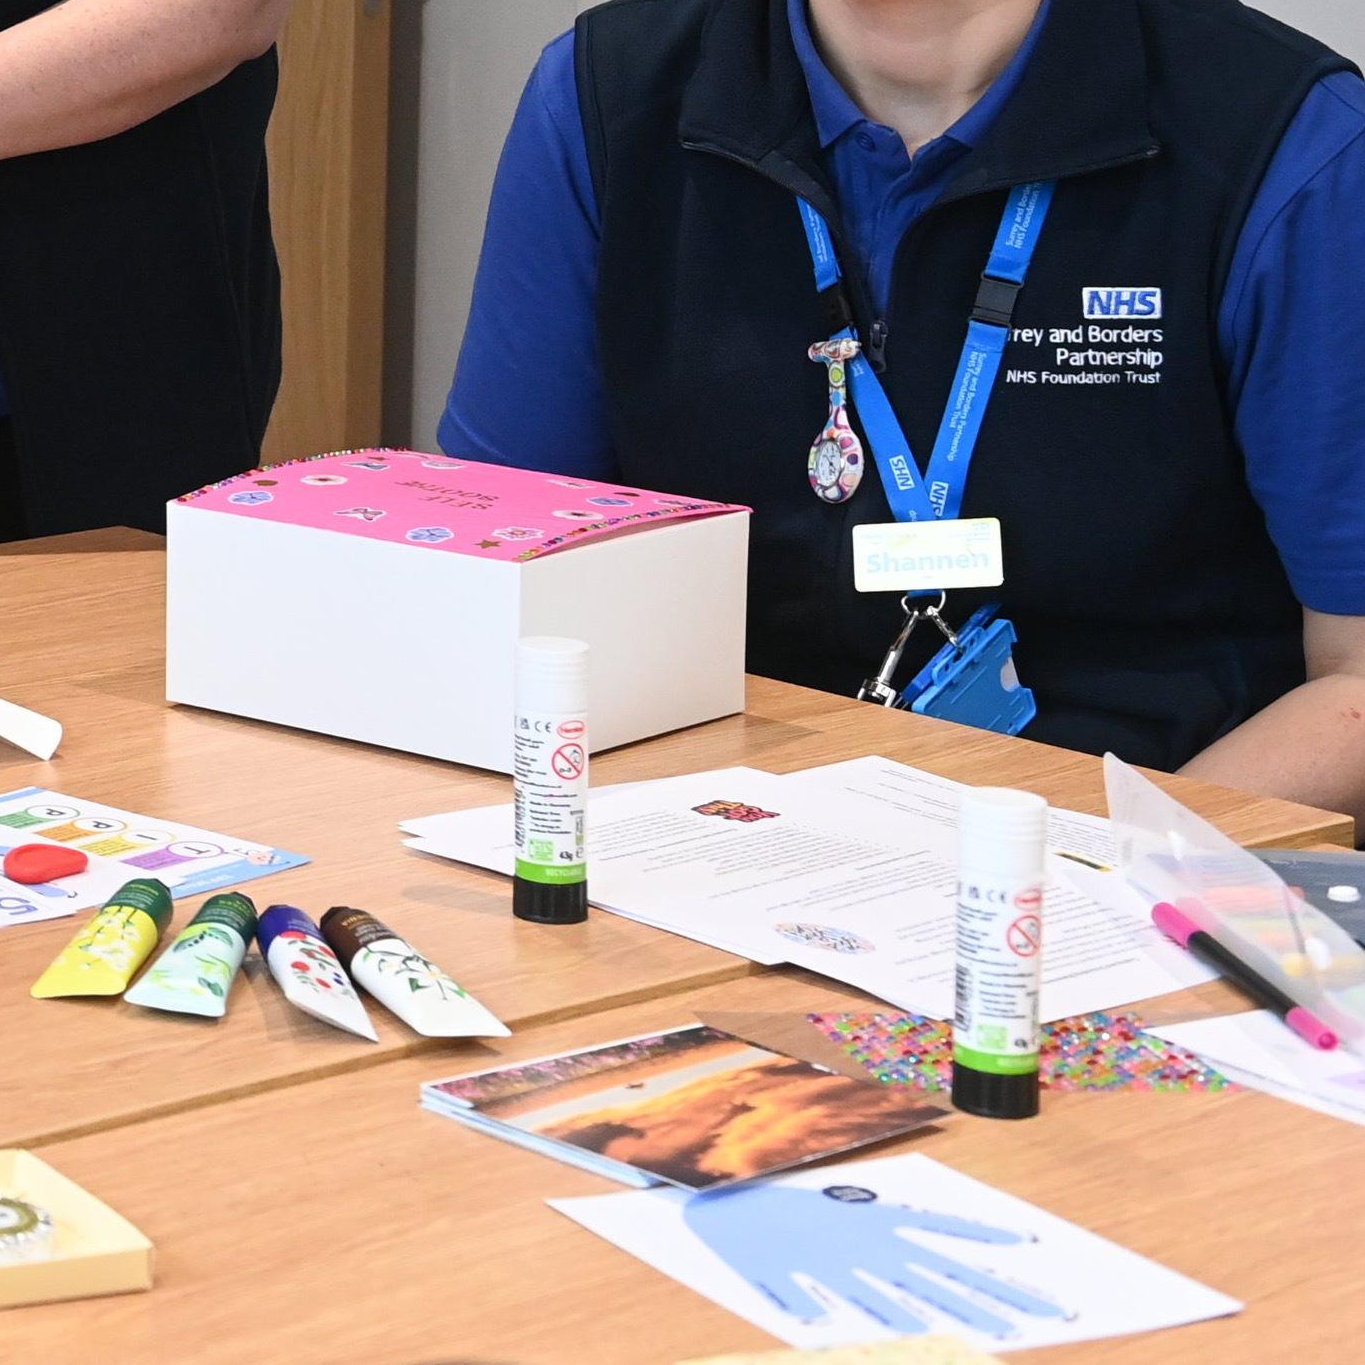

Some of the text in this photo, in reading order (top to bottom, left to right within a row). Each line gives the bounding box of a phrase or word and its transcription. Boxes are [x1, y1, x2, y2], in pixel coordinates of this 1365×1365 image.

[1087, 290, 1158, 316] NHS
[1049, 325, 1084, 343] and
[1087, 325, 1164, 343] Borders
[972, 352, 987, 377] Surrey
[1056, 348, 1163, 369] Partnership
[955, 367, 973, 410] Foundation
[1006, 369, 1162, 385] NHS Foundation Trust
[959, 391, 976, 421] Borders
[949, 411, 961, 429] Trust
[947, 420, 967, 462] Partnership
[891, 458, 913, 488] NHS
[418, 495, 493, 510] SELF
[867, 551, 990, 574] Shannen
